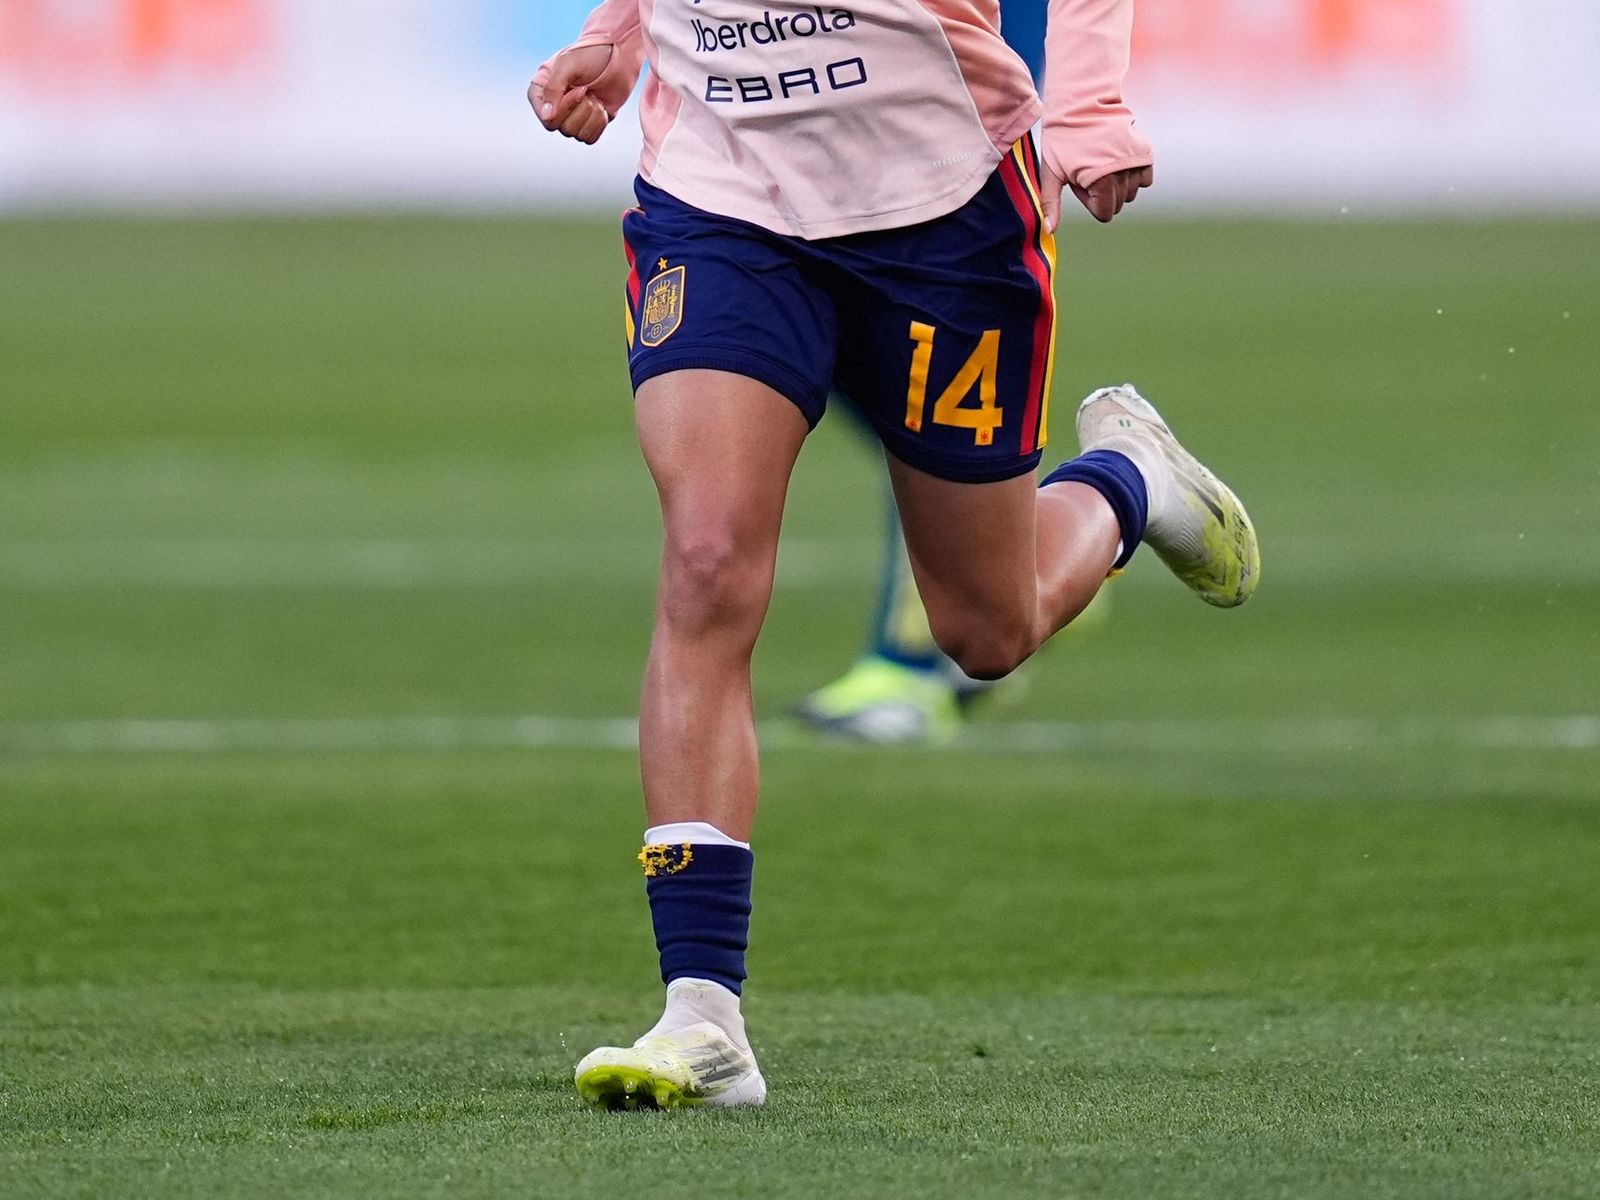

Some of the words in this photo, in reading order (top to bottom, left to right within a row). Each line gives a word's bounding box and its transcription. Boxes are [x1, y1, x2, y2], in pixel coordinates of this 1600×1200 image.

[691, 6, 855, 53] Iberdrola
[705, 57, 867, 102] EBRO
[904, 320, 1002, 446] 14
